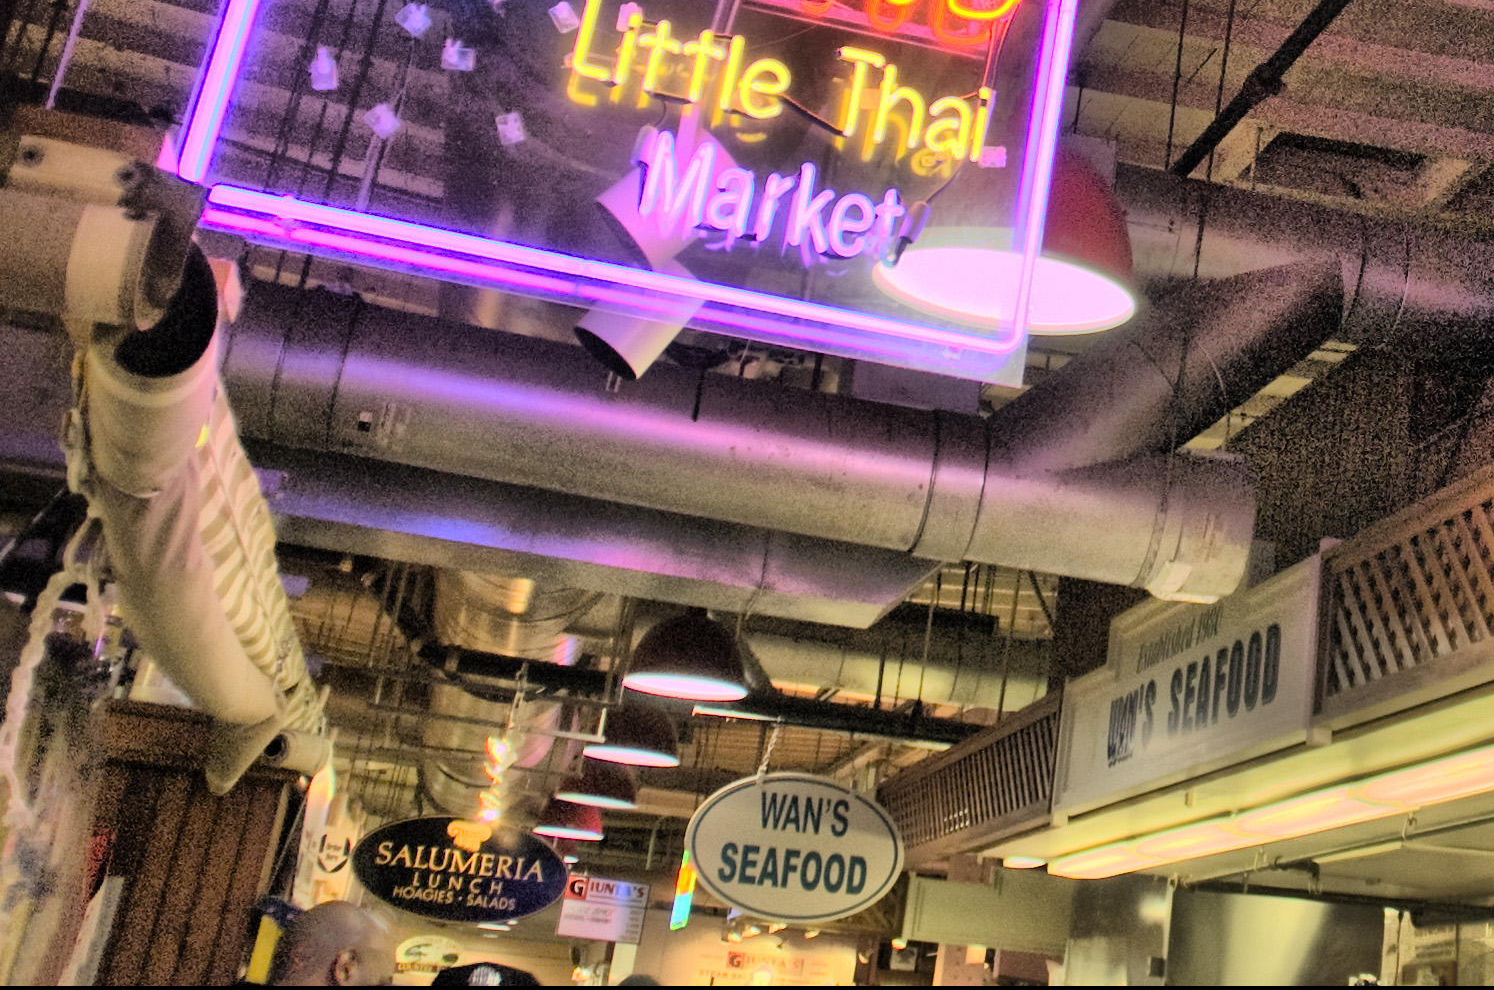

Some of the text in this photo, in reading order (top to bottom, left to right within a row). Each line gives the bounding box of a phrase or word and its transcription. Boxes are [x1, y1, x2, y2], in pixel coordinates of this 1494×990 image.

[838, 46, 993, 162] Thai
[638, 130, 907, 266] Market
[1107, 622, 1282, 767] WAN'S SEAFOOD
[761, 791, 850, 838] WAN'S
[374, 840, 545, 884] SALUMERIA
[412, 871, 504, 896] LUNCH
[717, 842, 868, 896] SEAFOOD
[392, 885, 517, 912] HOAGIES SALADS
